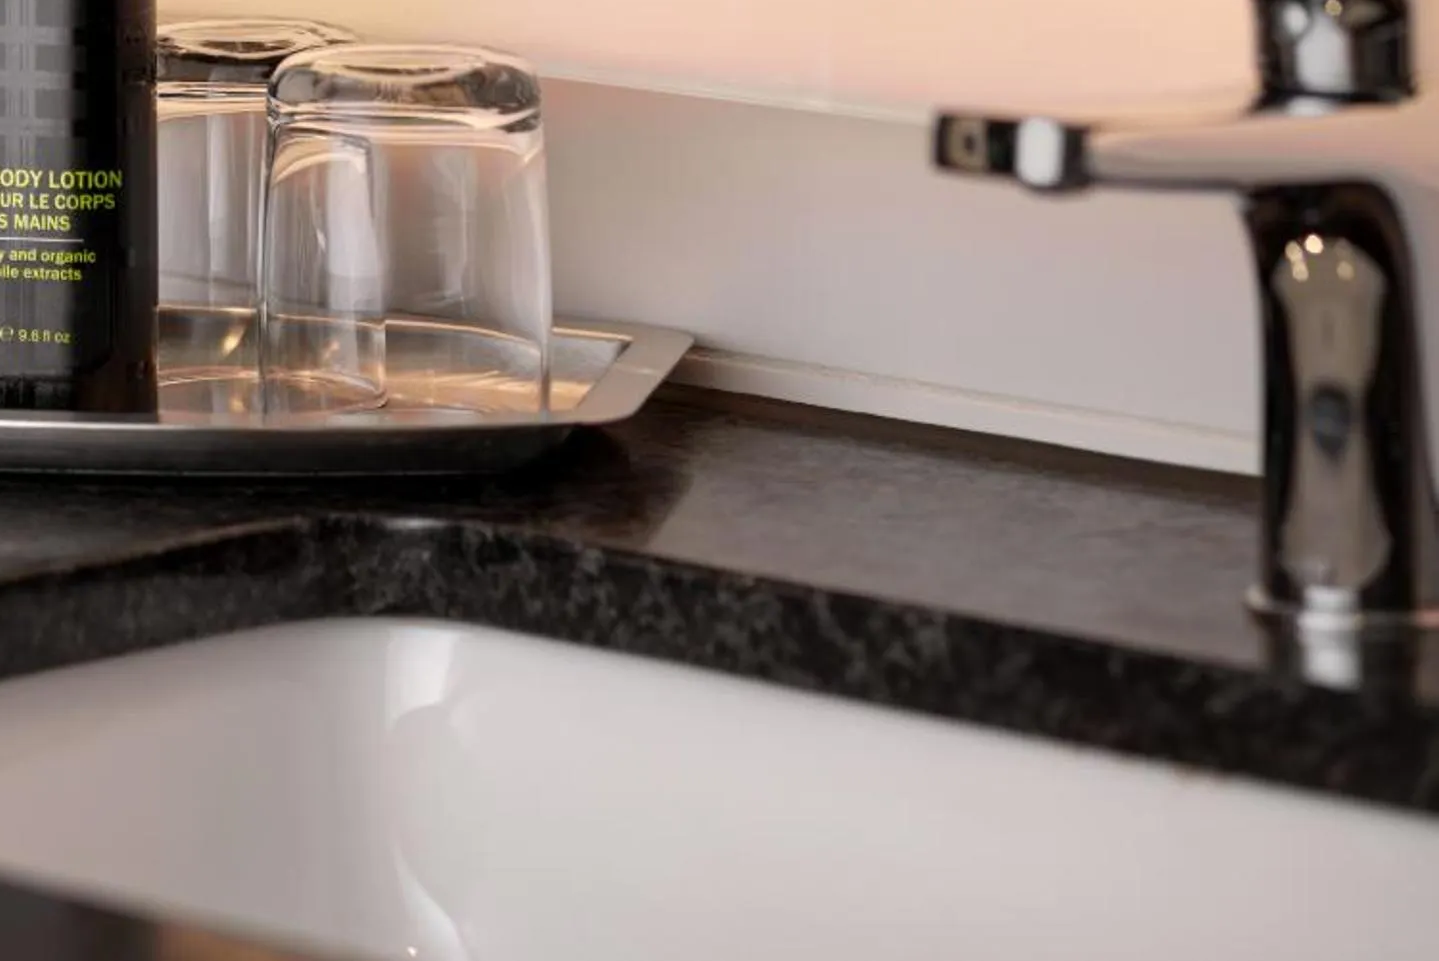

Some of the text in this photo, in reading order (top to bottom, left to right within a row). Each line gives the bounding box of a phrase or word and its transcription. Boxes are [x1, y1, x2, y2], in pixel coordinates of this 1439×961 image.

[49, 170, 123, 189] LOTION
[30, 193, 49, 209] LE
[55, 194, 115, 210] CORPS
[14, 214, 71, 232] MAINS
[10, 248, 36, 262] and
[41, 249, 96, 266] organic
[23, 266, 82, 281] extracts
[54, 331, 71, 344] oz
